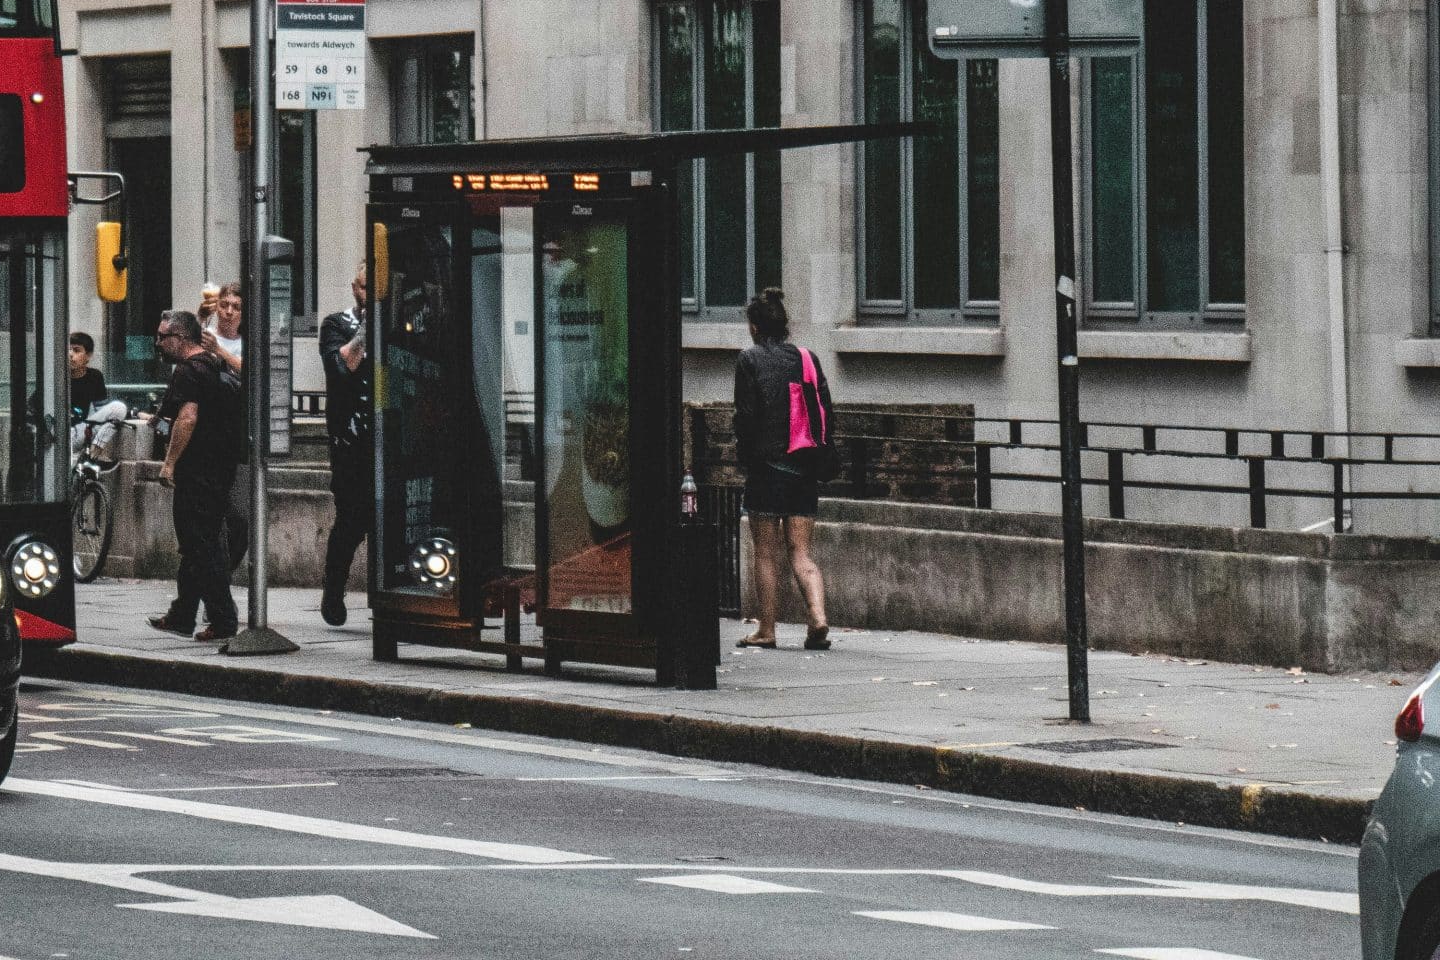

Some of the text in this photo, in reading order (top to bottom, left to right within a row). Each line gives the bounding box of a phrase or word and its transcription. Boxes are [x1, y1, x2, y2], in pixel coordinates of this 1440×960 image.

[289, 12, 355, 23] Tavistock Square
[287, 41, 355, 50] towards Aldwych
[285, 65, 298, 75] 59
[315, 65, 328, 75] 68
[346, 65, 357, 75] 91
[282, 90, 300, 101] 168
[311, 89, 332, 101] N91
